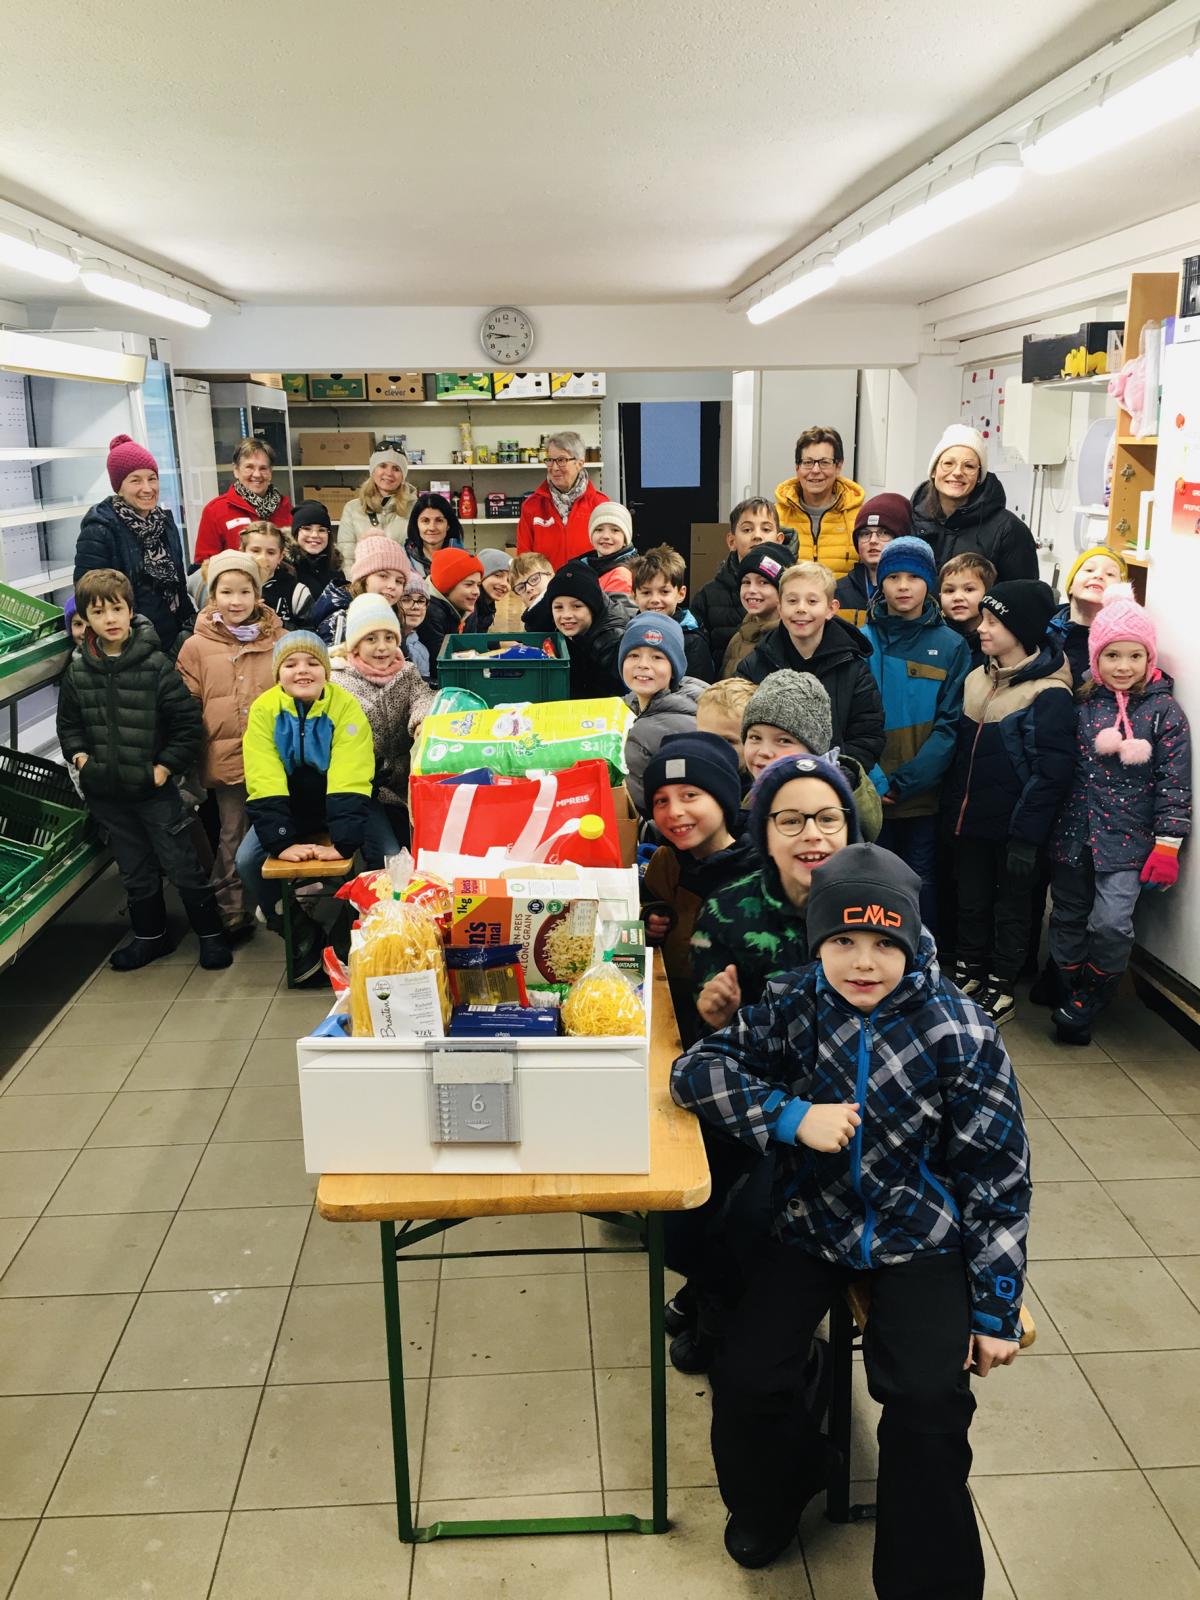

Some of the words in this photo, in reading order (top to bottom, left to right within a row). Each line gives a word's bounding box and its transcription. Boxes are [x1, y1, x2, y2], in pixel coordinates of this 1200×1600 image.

[384, 389, 406, 397] clever
[556, 794, 590, 808] MPREIS
[457, 898, 473, 915] 1kg
[843, 904, 902, 928] CMP
[464, 921, 487, 945] n's
[486, 922, 502, 945] inal
[513, 913, 523, 945] RN-REIS
[523, 914, 533, 941] GRAIN
[521, 942, 530, 963] LONG
[471, 1094, 485, 1112] 6
